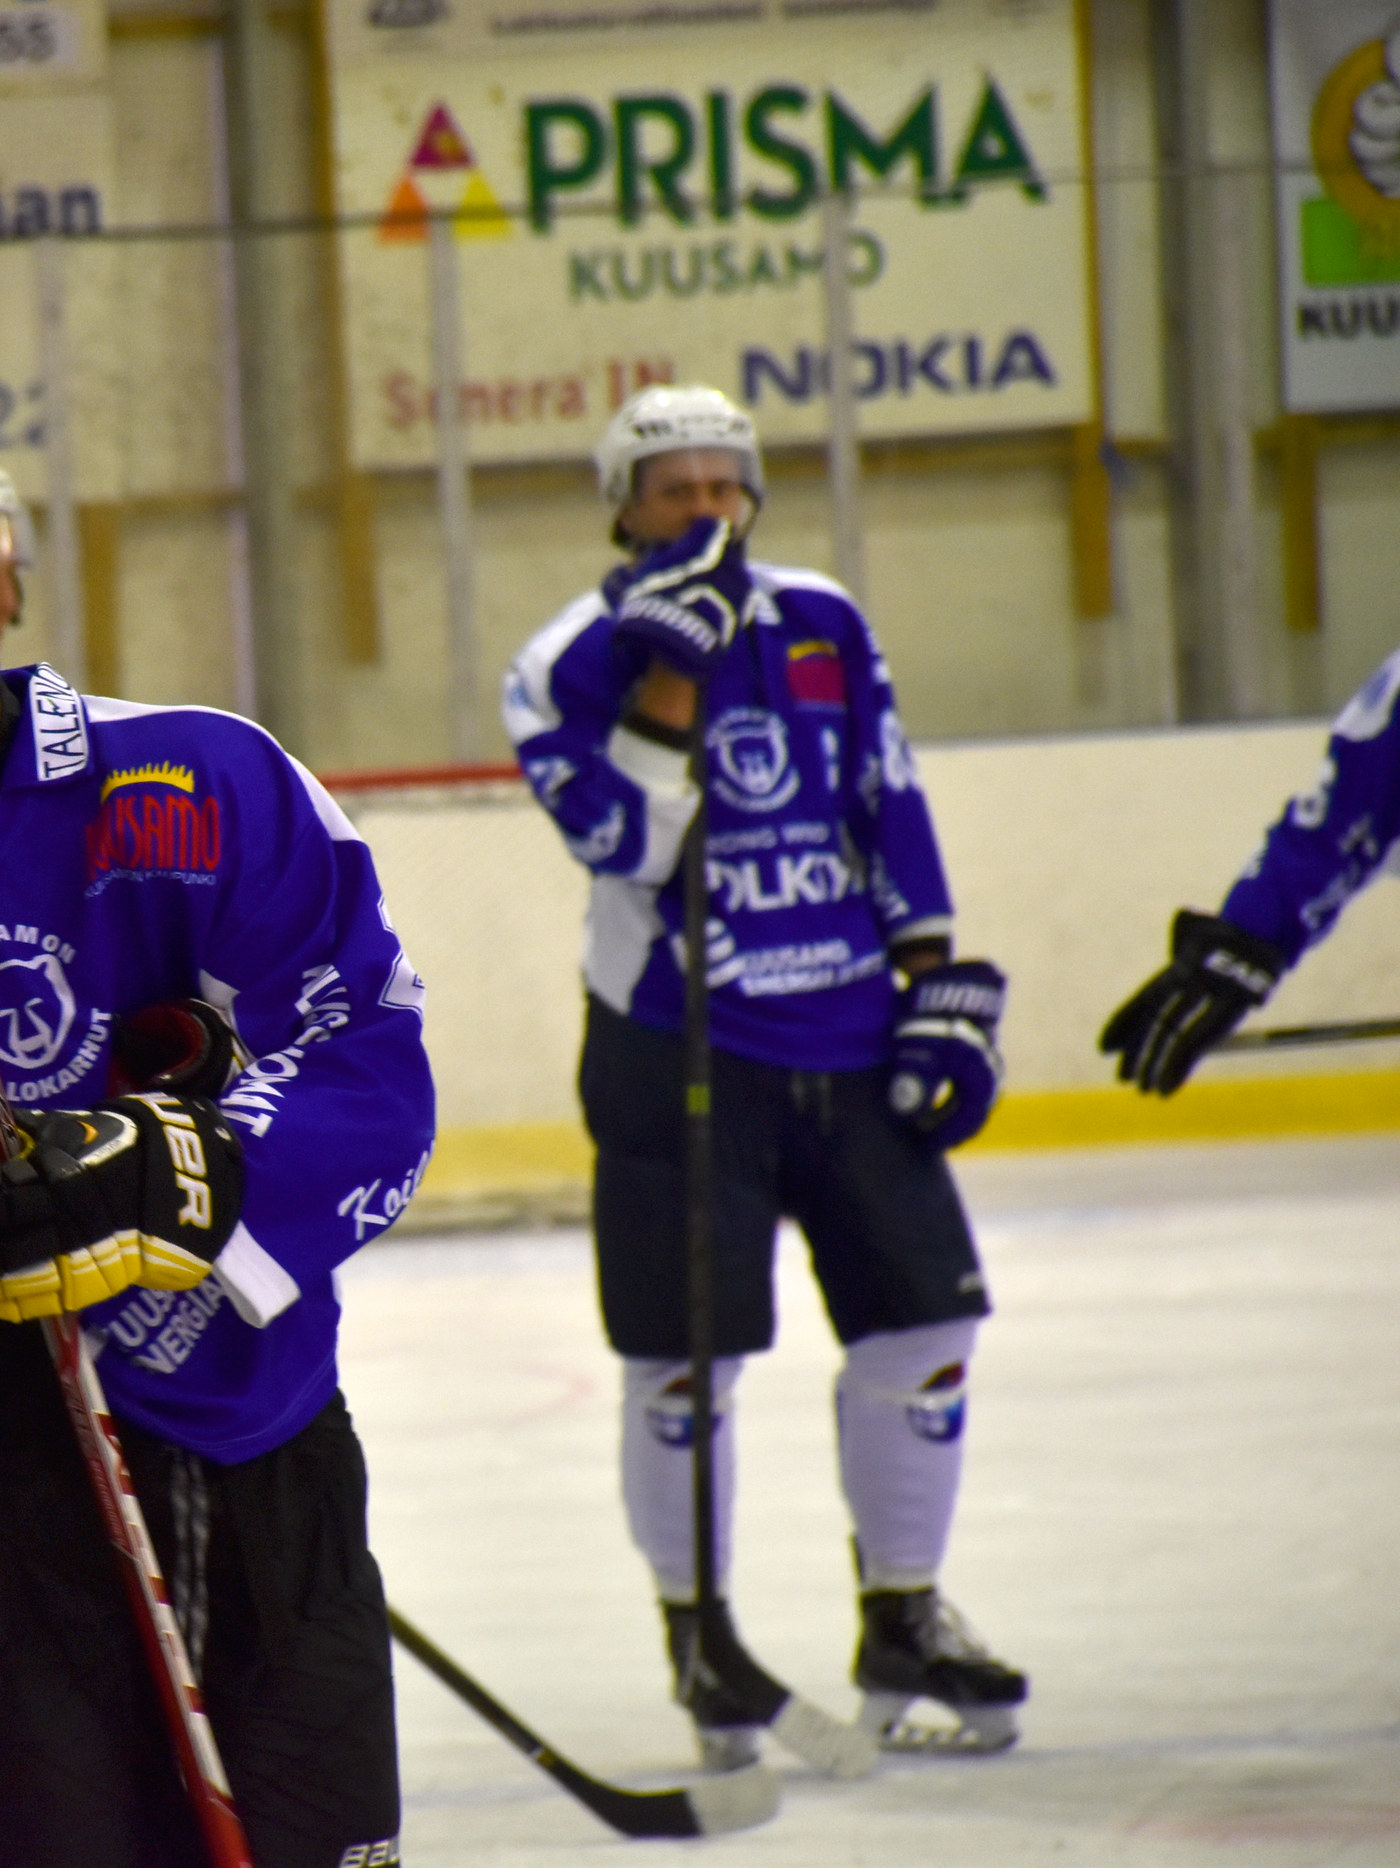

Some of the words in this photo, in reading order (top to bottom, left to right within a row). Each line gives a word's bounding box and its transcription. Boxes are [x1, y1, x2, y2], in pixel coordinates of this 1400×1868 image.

[522, 68, 1048, 236] PRISMA
[567, 230, 887, 302] KUUSAMO
[739, 327, 1058, 405] NOKIA
[35, 663, 86, 779] TALENO
[4, 1007, 113, 1102] LOKARHUT
[128, 1092, 213, 1231] UER
